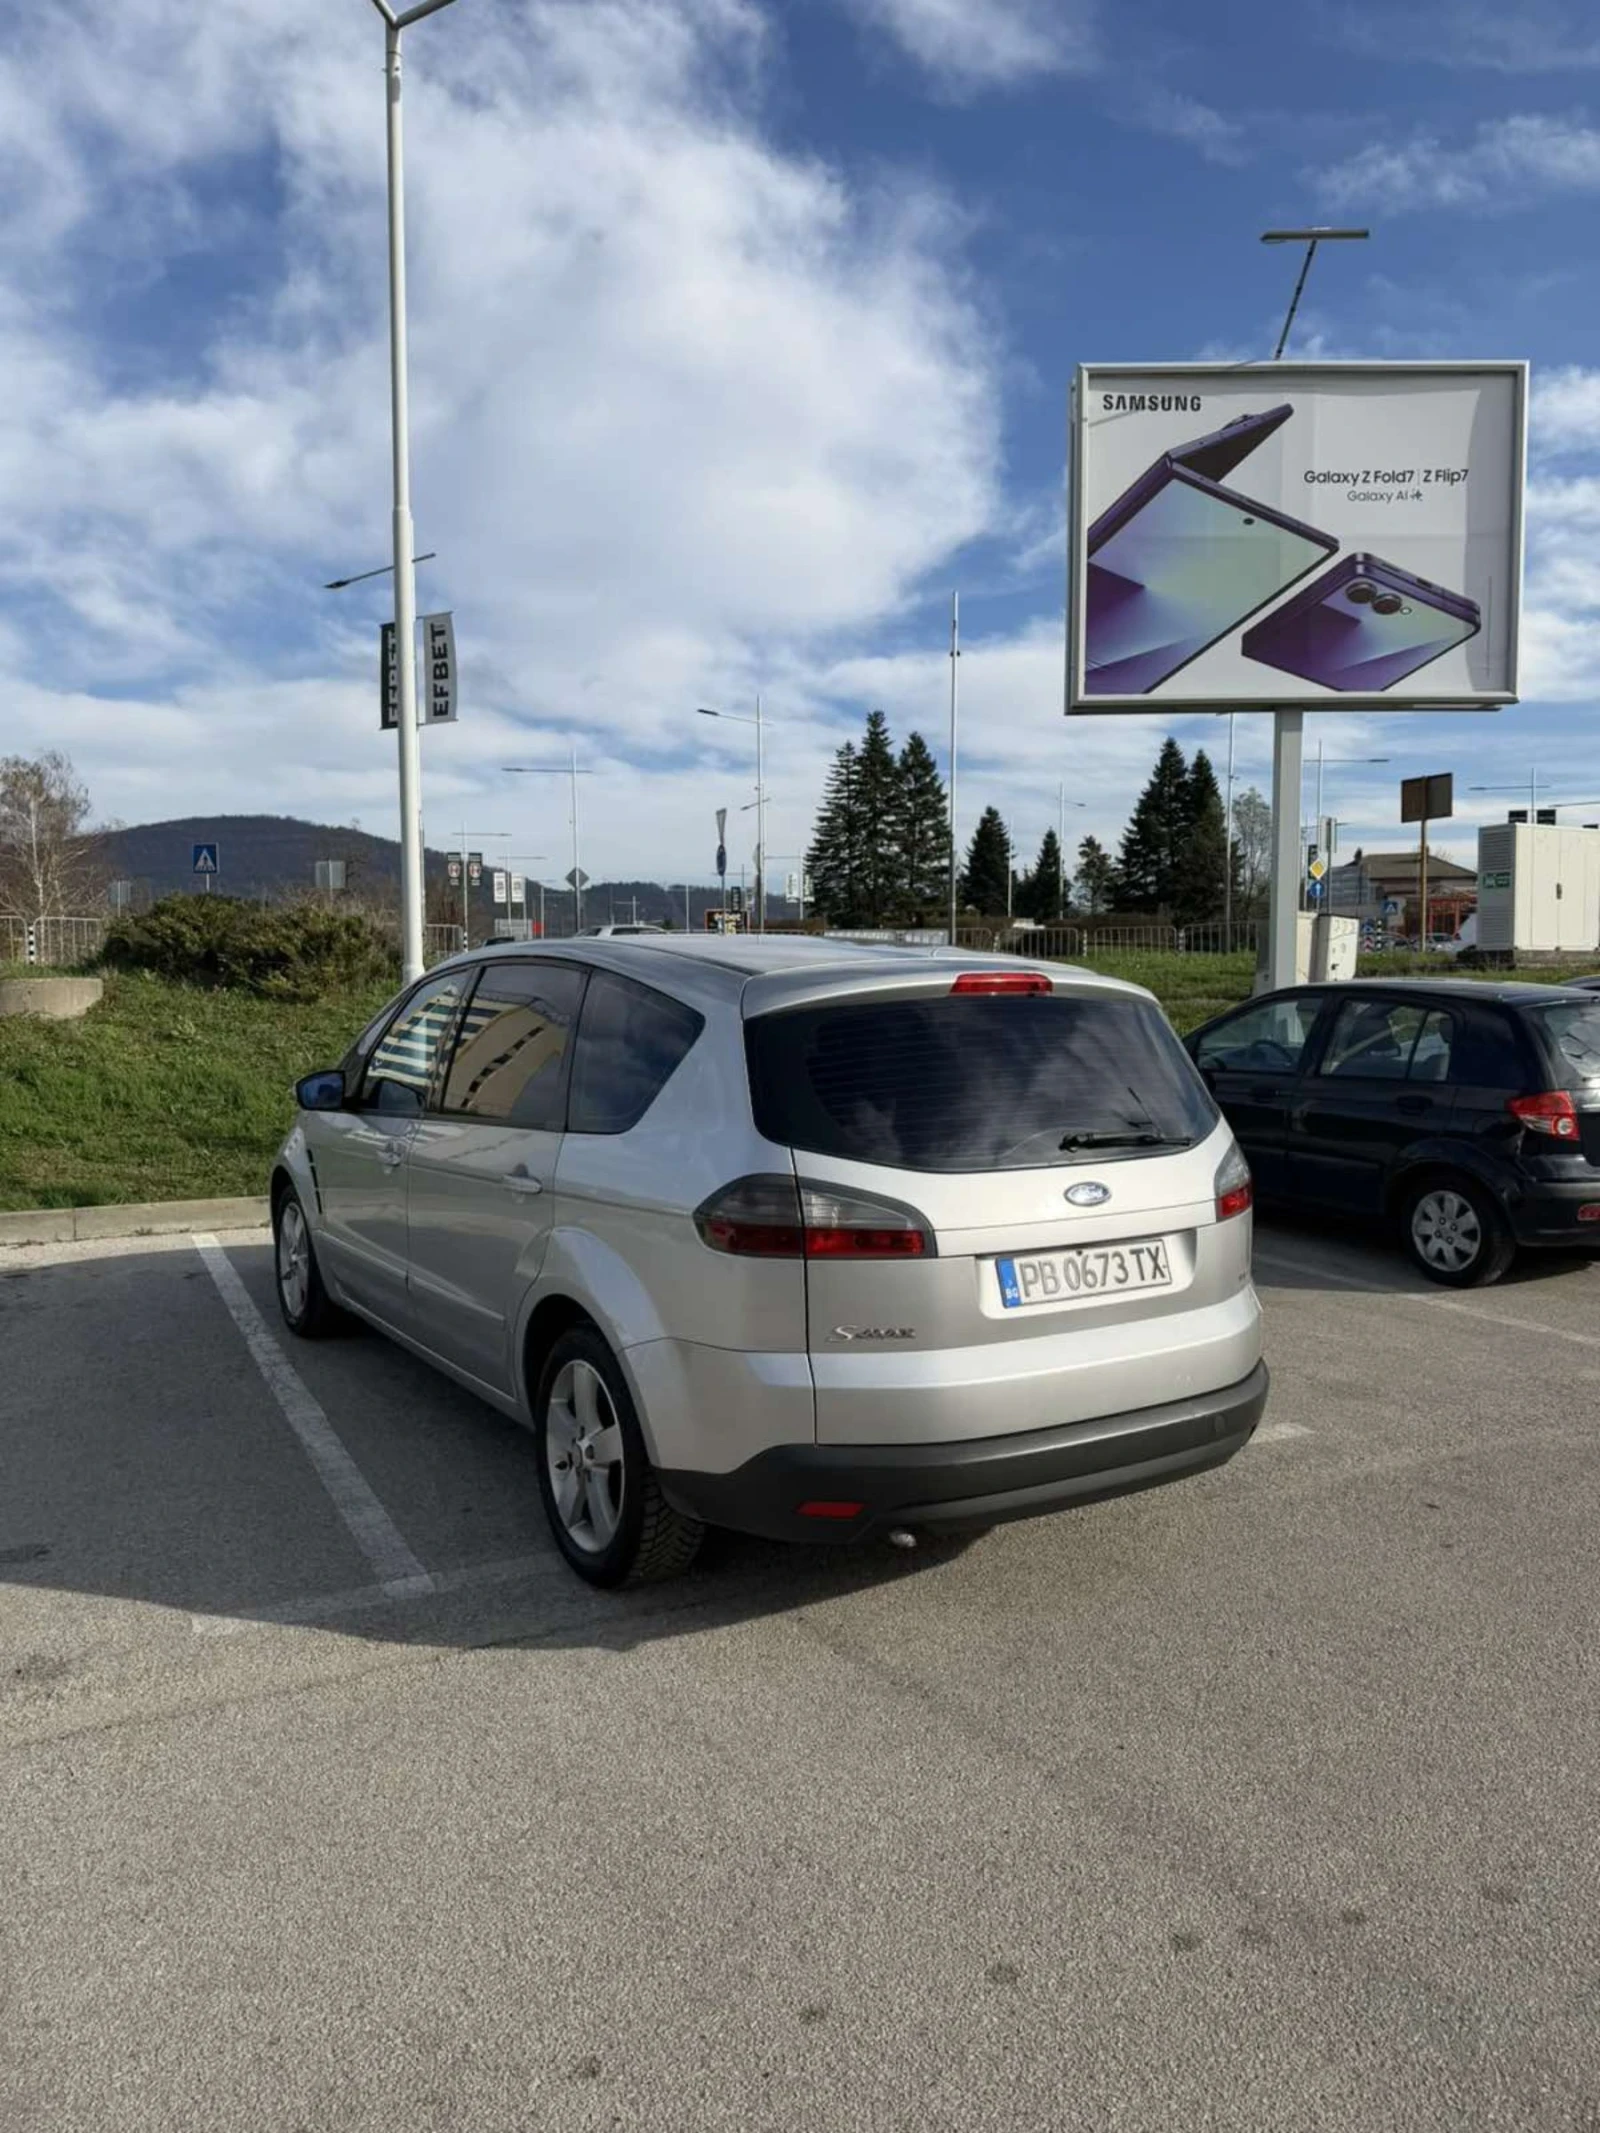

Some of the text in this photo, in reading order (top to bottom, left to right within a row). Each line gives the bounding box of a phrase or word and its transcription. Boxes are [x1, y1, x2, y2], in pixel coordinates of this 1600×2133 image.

[1102, 393, 1202, 413] SAMSUNG
[1303, 468, 1470, 487] Galaxy Z Fold7 Z Flip7
[1346, 490, 1409, 504] Galaxy AI
[429, 622, 449, 717] EFBET
[1018, 1245, 1167, 1298] PB 0673 TX
